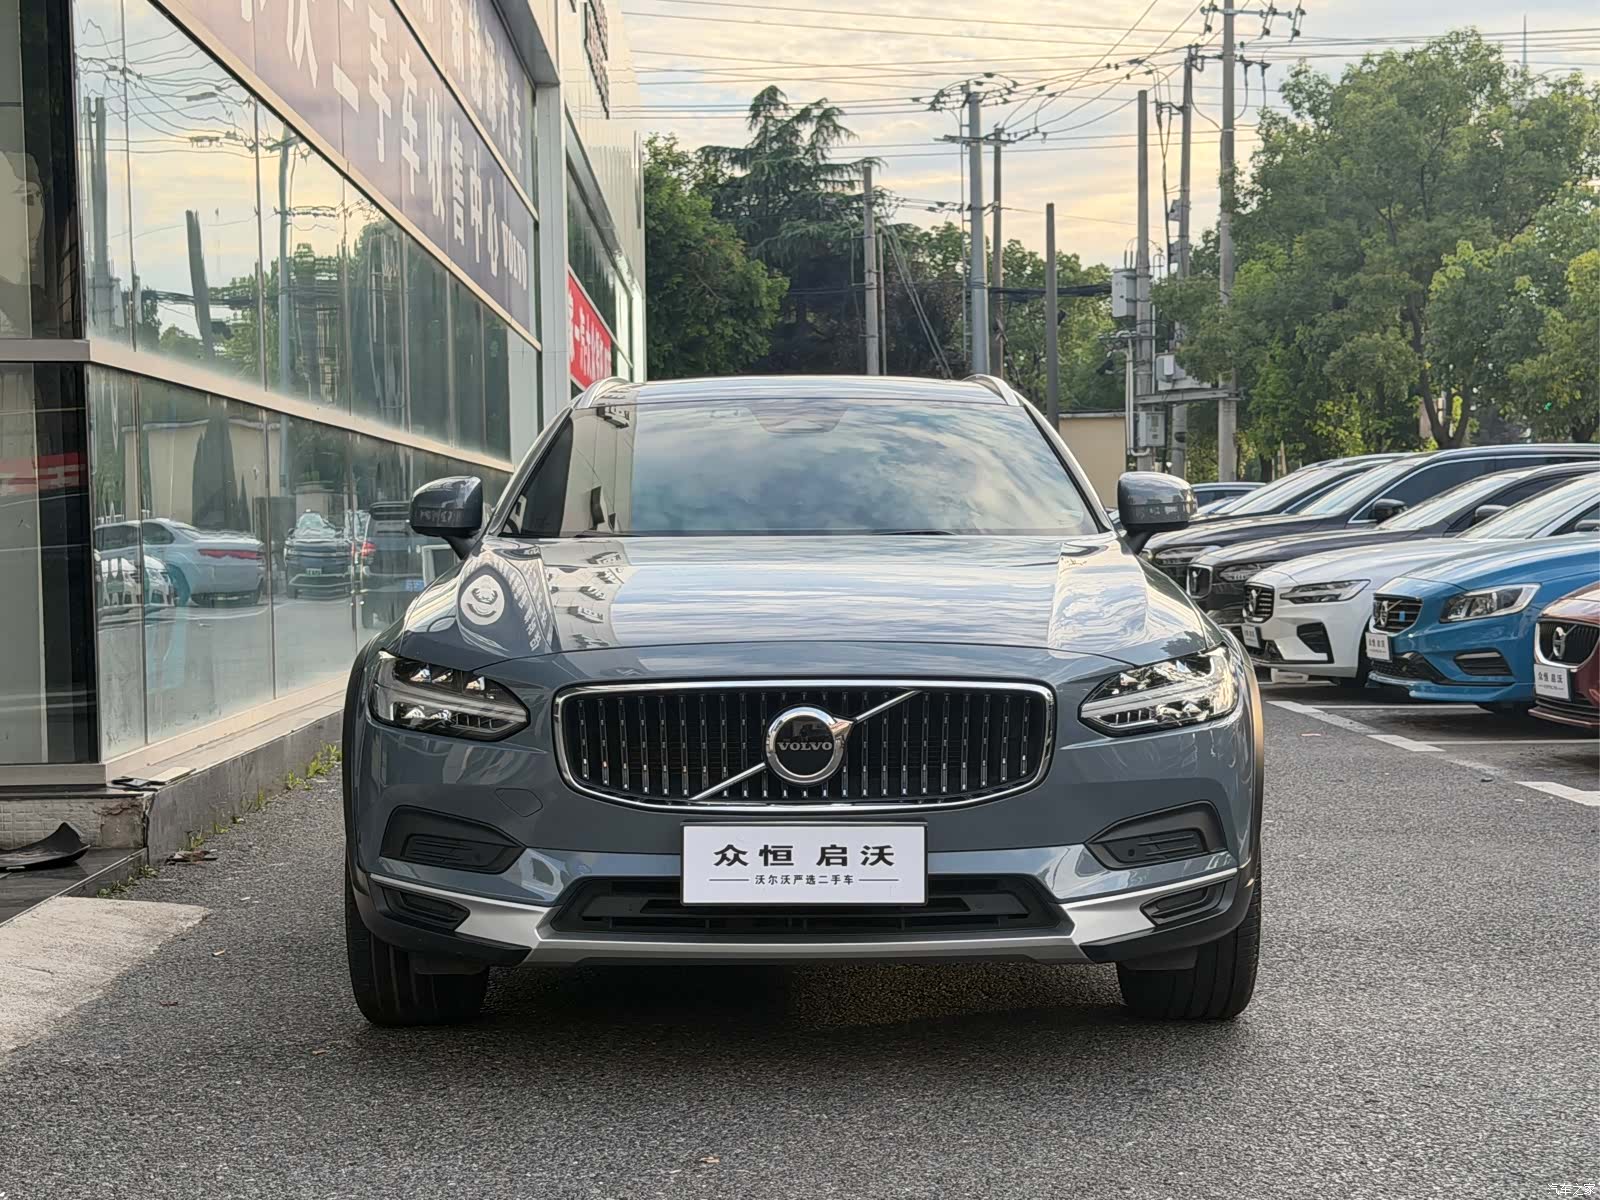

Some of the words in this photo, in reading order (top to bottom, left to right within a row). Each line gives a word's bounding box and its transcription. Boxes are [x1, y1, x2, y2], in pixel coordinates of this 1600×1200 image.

[501, 219, 528, 291] VOLVO
[776, 741, 833, 751] VOLVO
[755, 874, 854, 885] 沃尔沃严选二手车
